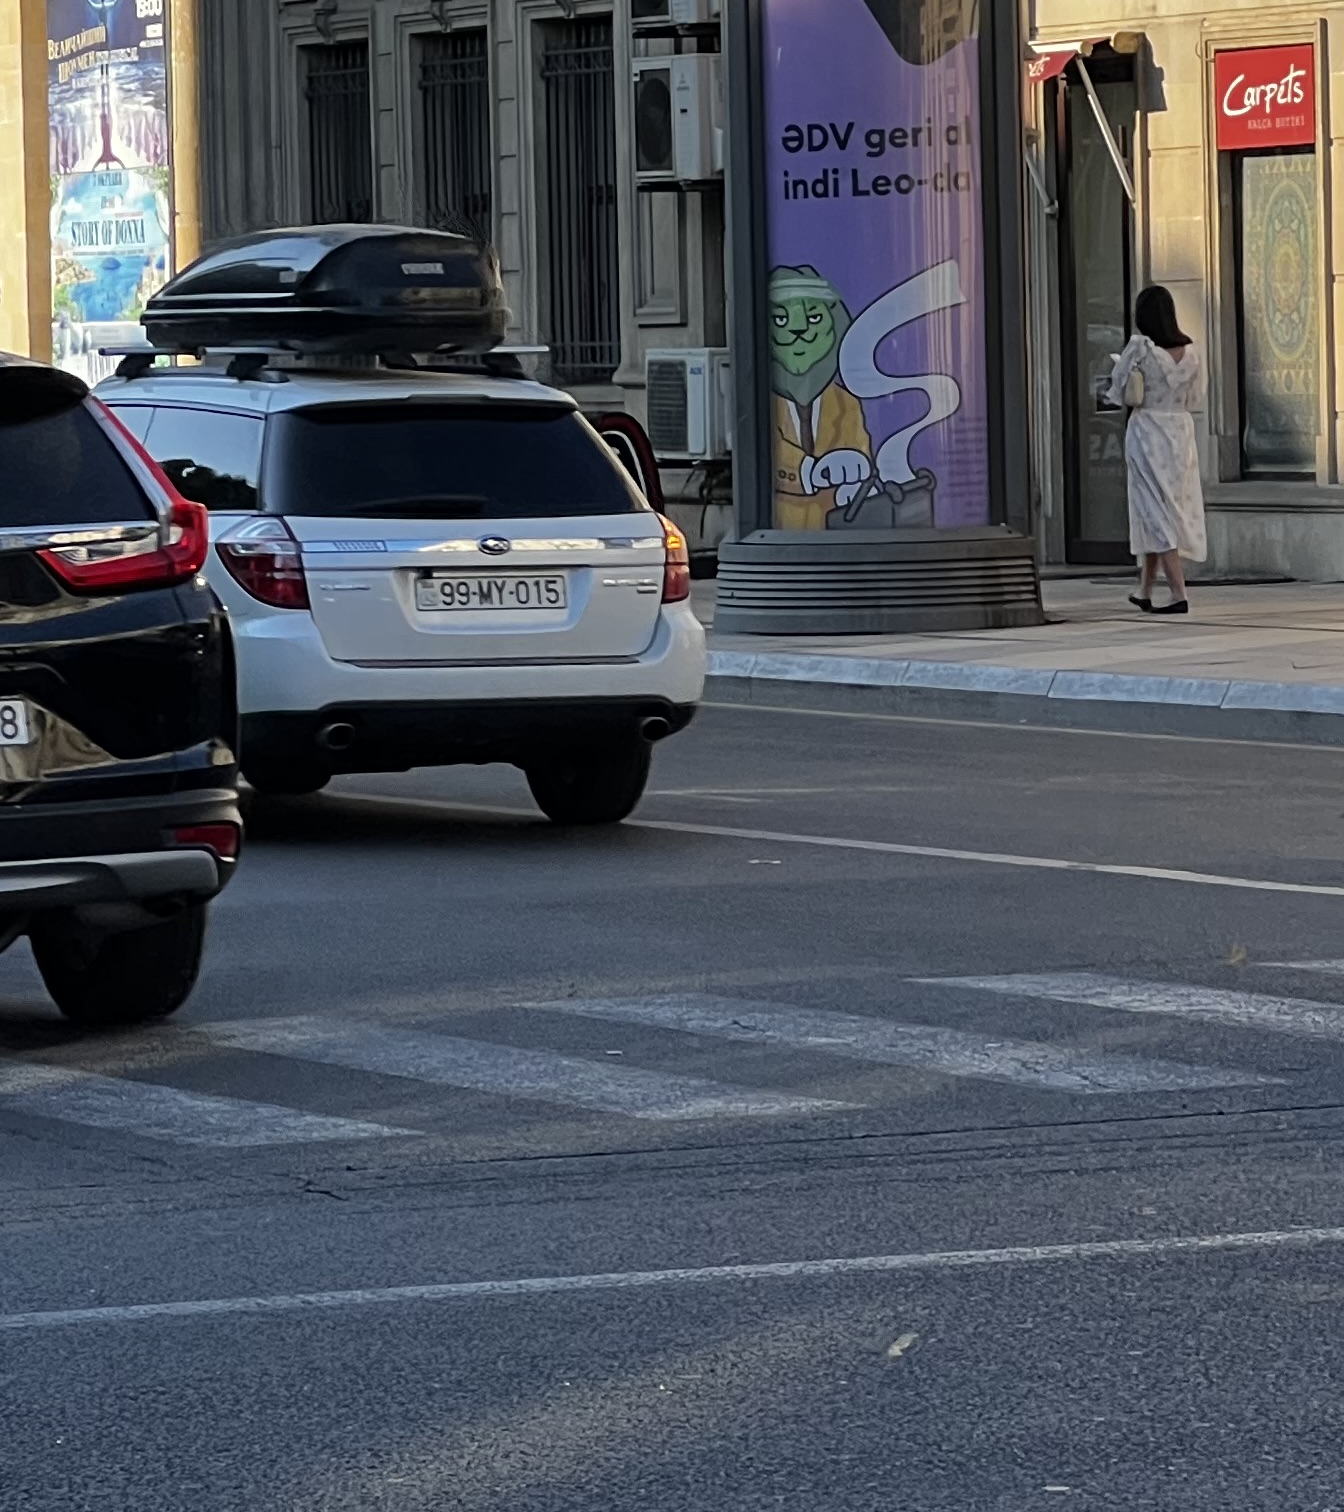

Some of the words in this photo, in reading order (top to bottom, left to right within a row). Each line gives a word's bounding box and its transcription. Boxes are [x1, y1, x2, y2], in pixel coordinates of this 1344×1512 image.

[1222, 63, 1306, 116] Carpets
[782, 121, 855, 153] ƏDV
[864, 117, 933, 158] geri
[945, 115, 971, 146] al
[783, 168, 839, 200] indi
[851, 162, 971, 197] Leo-da
[71, 220, 100, 246] STORY
[101, 220, 112, 245] OF
[440, 580, 560, 606] 99-MY-015
